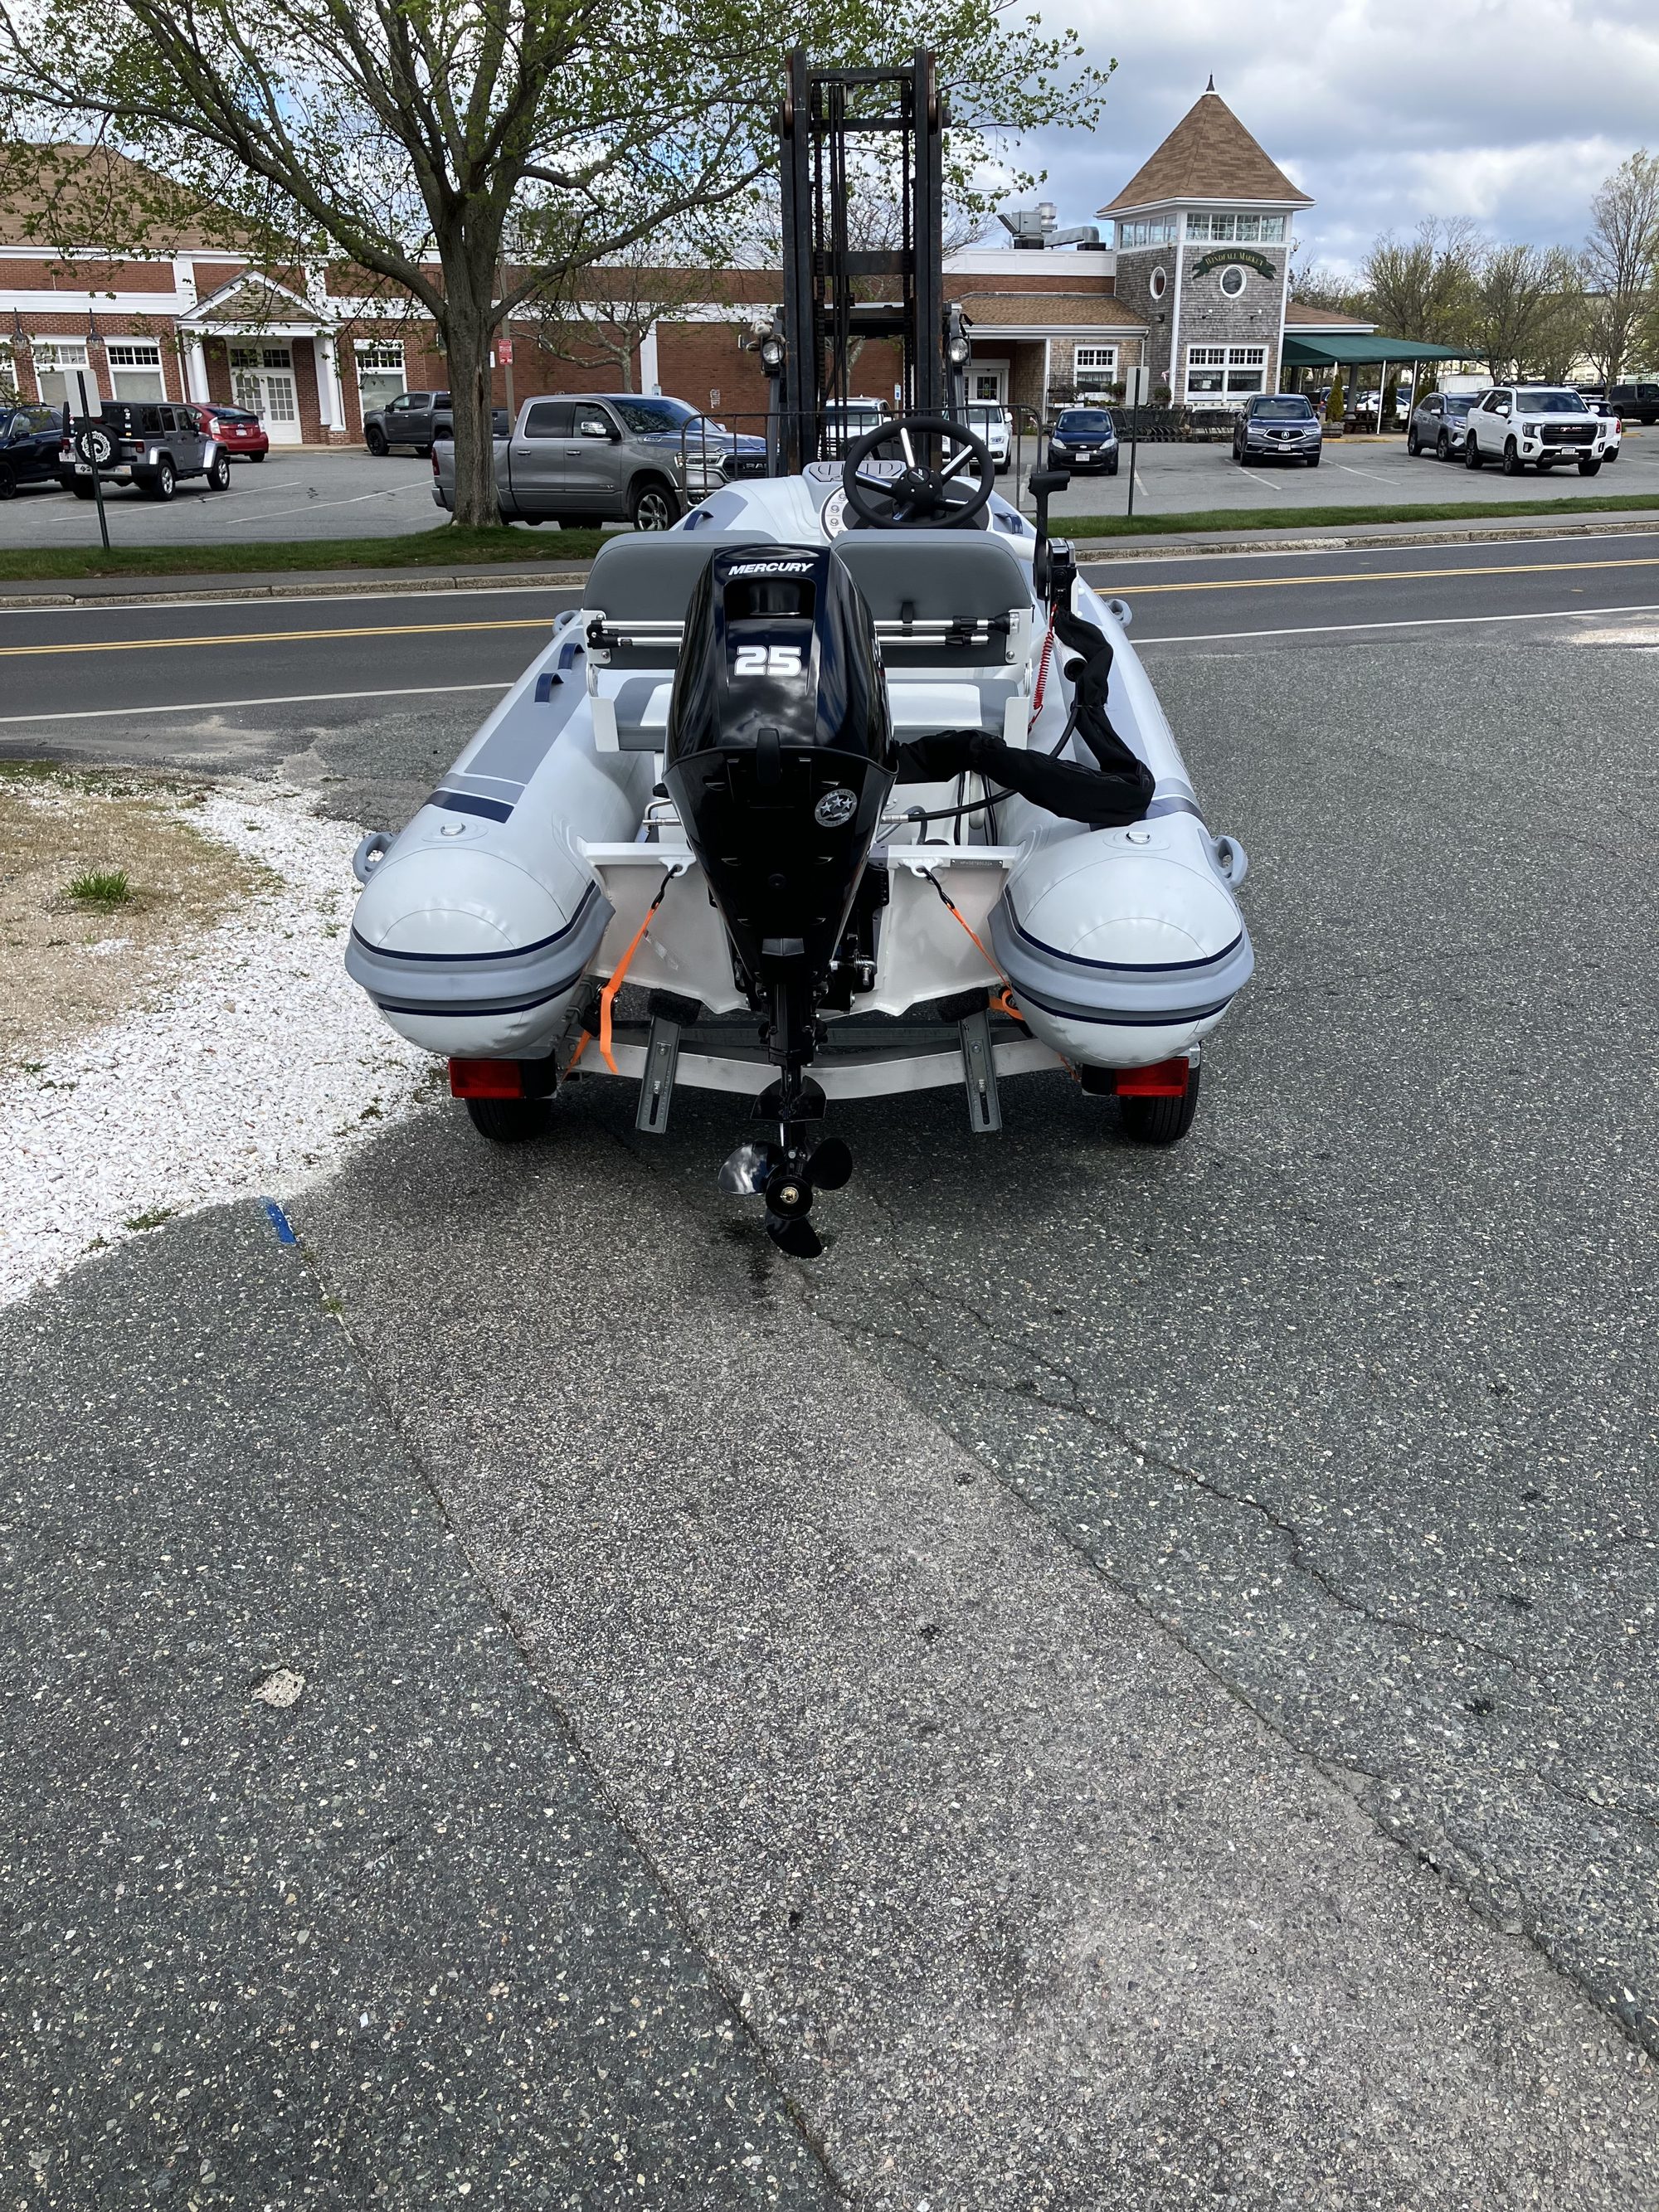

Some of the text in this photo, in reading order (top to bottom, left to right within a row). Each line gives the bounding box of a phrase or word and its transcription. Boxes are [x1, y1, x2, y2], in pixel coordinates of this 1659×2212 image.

[1205, 252, 1263, 266] WINDFALL MARKET
[728, 562, 815, 576] MERCURY
[734, 644, 802, 676] 25
